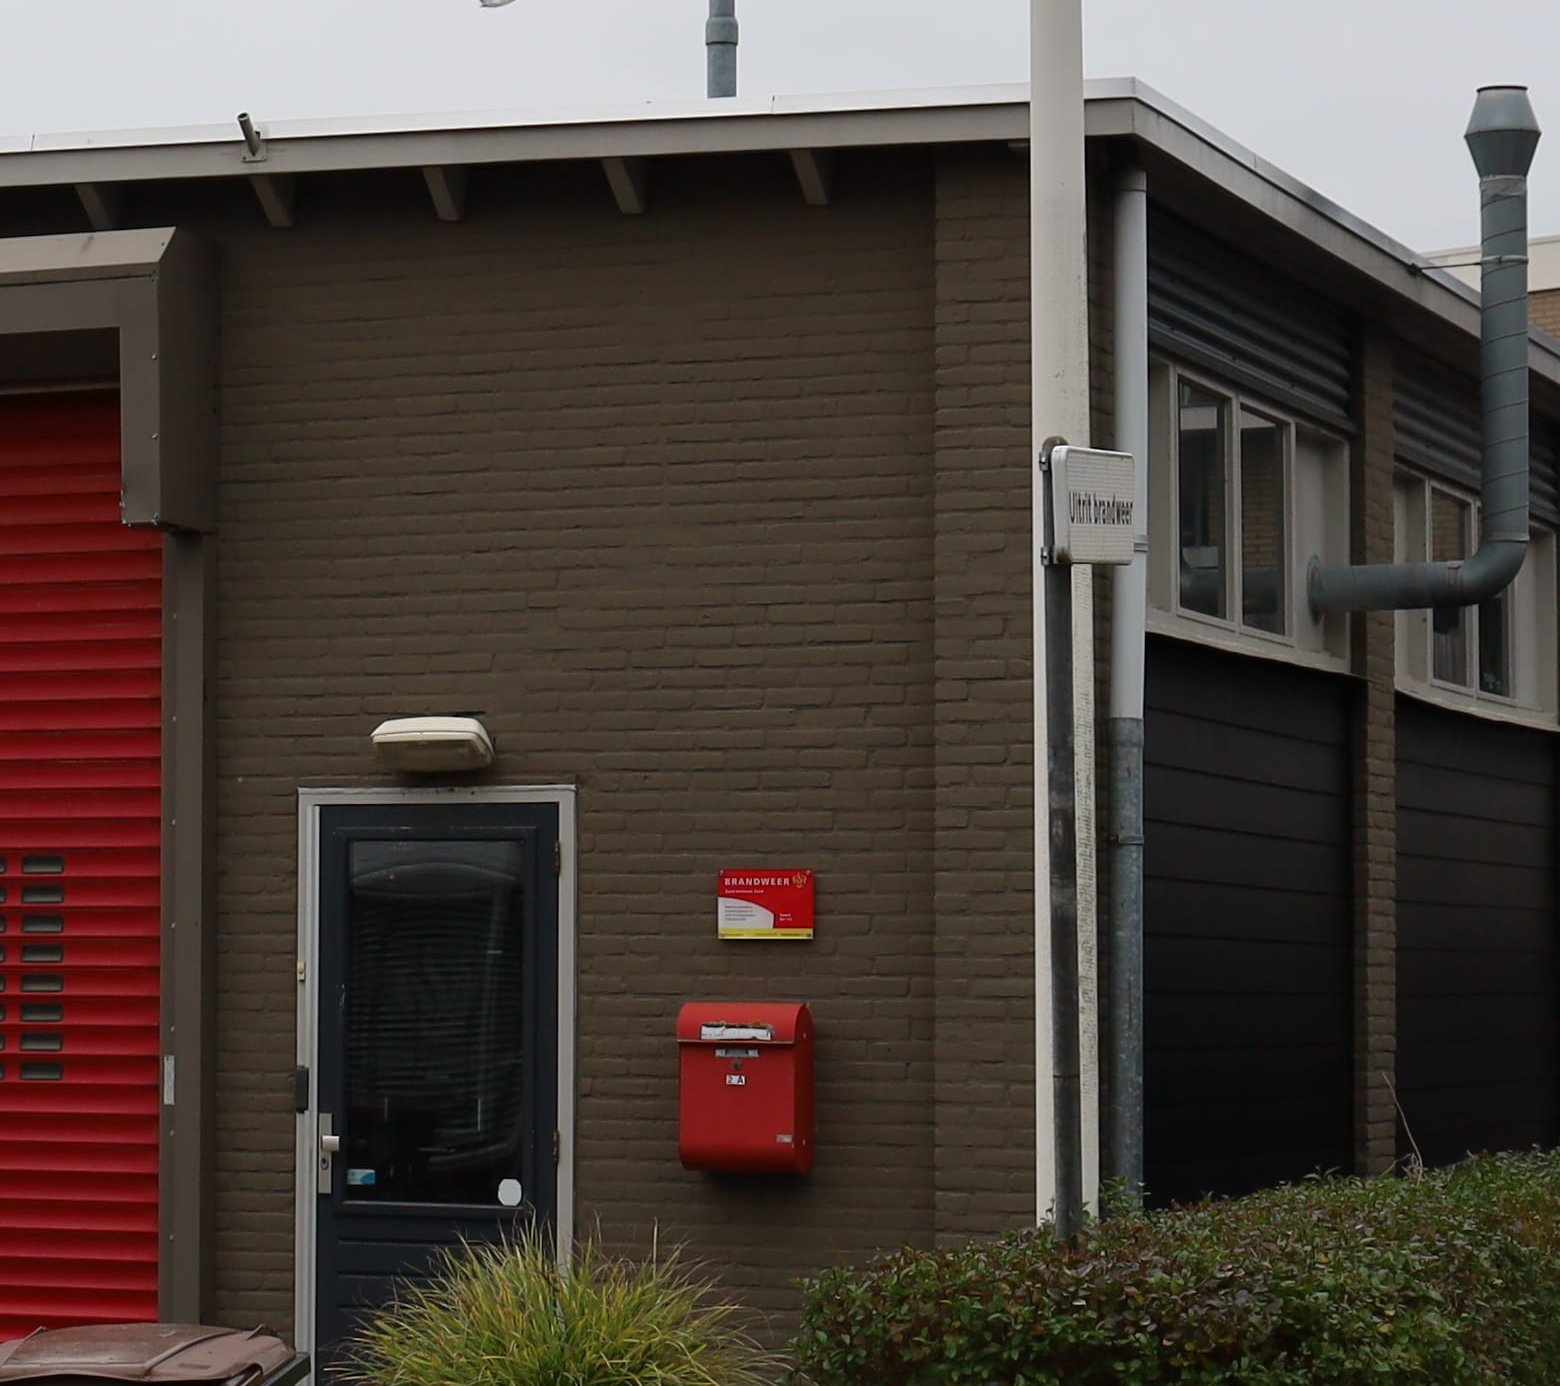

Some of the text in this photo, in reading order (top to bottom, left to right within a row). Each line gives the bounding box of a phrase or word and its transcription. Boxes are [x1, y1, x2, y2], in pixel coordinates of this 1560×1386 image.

[1069, 491, 1133, 525] Uitrit brandweer
[724, 878, 790, 886] BRANDWEER
